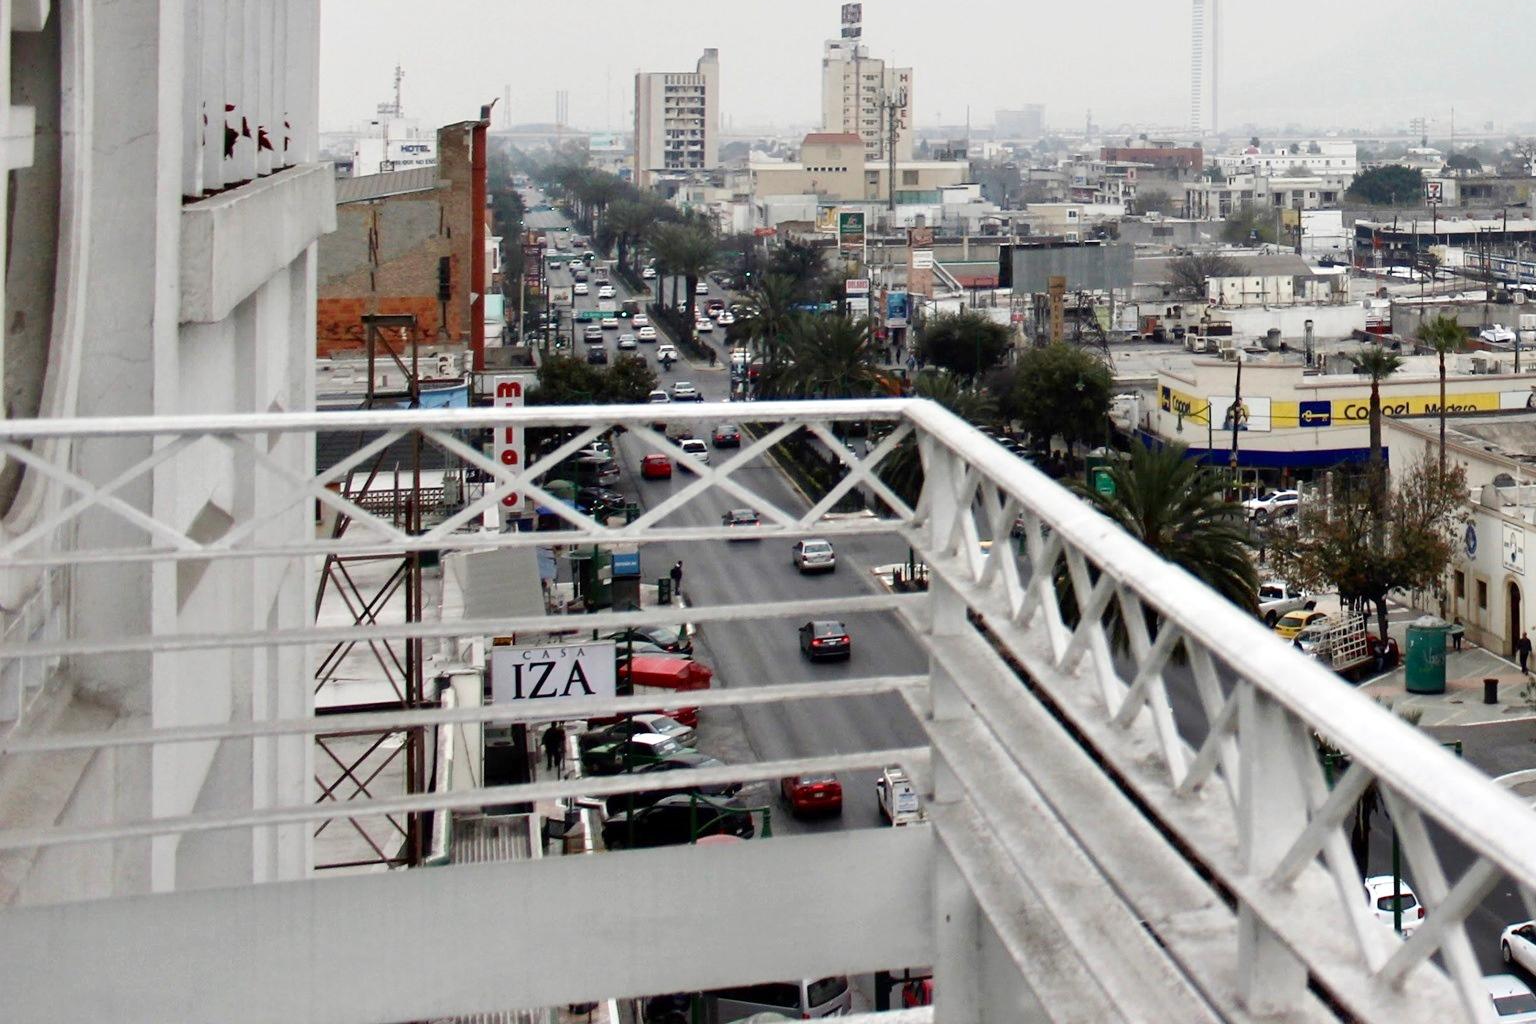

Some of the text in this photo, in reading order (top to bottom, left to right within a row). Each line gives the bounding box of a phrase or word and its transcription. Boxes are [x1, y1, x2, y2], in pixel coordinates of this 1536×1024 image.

[400, 144, 431, 153] HOTEL
[1344, 401, 1410, 420] Copel
[522, 647, 586, 660] CASA
[511, 659, 597, 700] IZA
